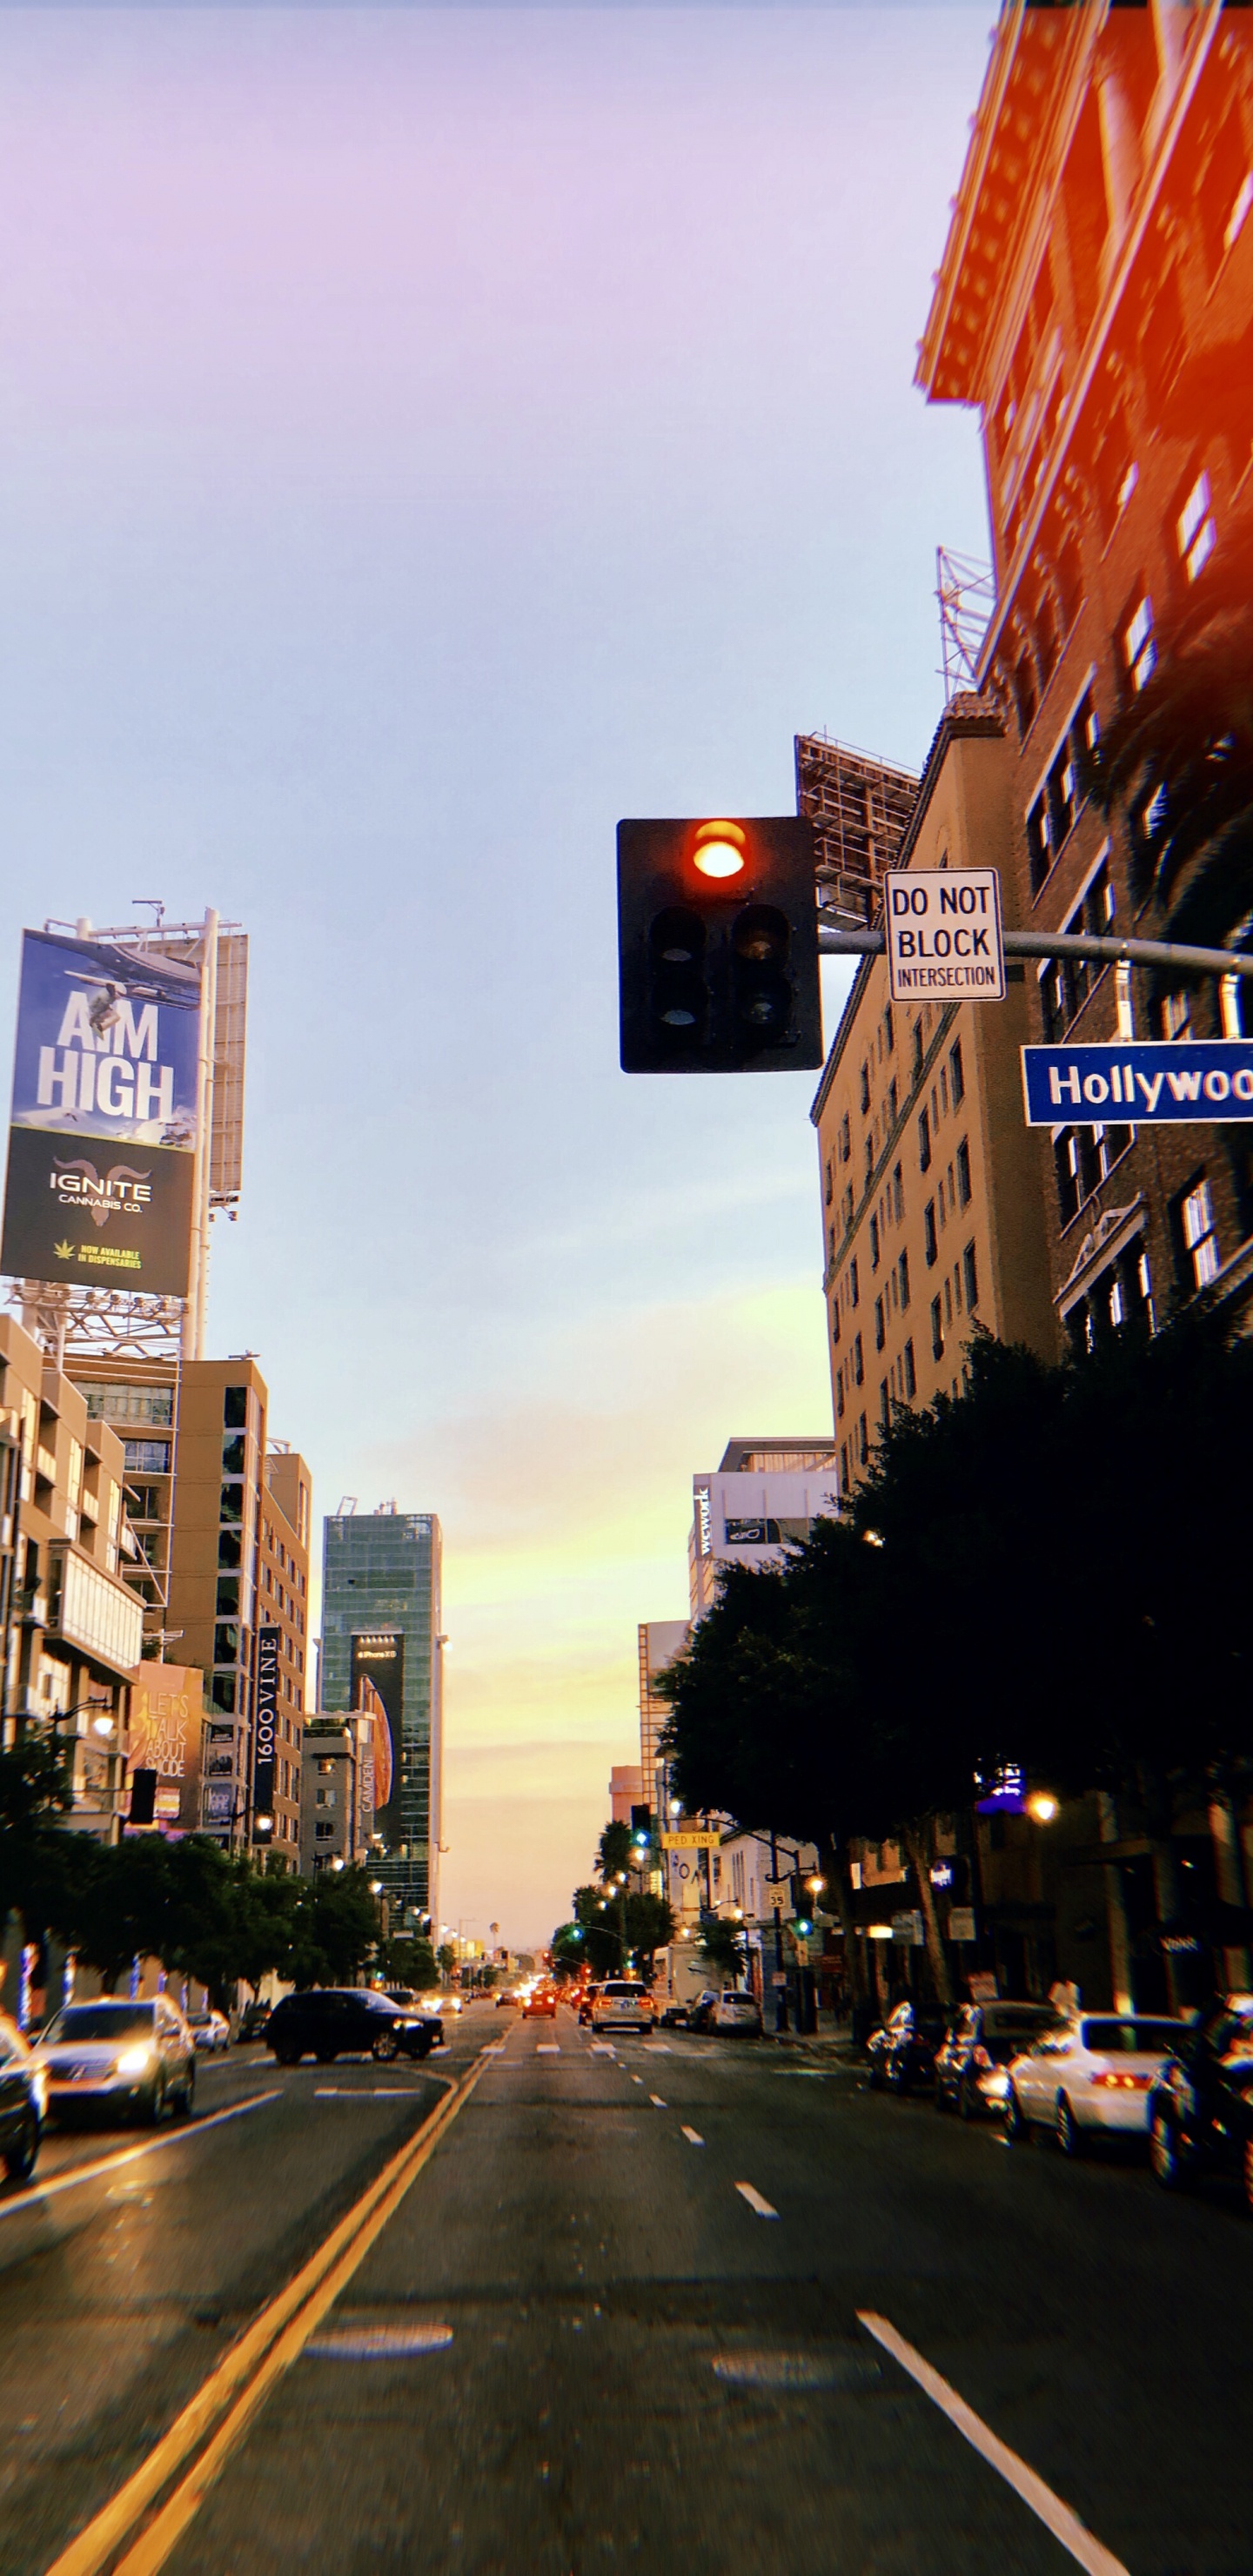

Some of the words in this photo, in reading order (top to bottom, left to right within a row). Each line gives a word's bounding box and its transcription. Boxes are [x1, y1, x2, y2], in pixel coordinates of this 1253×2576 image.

[893, 888, 928, 916] DO
[940, 886, 990, 915] NOT
[899, 929, 990, 957] BLOCK
[898, 965, 995, 988] INTERSECTION
[37, 1046, 174, 1120] HIGH
[1049, 1064, 1253, 1112] Hollywoo
[50, 1172, 151, 1202] IGNITE
[58, 1194, 122, 1211] CANNABIS
[124, 1203, 143, 1213] CO.
[77, 1253, 86, 1262] IN
[88, 1254, 142, 1269] DISPENSARIES
[81, 1244, 99, 1254] NOW
[100, 1247, 140, 1259] AVAILABLE
[694, 1487, 711, 1556] wework
[259, 1638, 277, 1704] VINE
[148, 1692, 189, 1718] LET'S
[148, 1715, 188, 1741] TALK
[257, 1708, 274, 1765] 1600
[145, 1738, 187, 1760] ABOUT
[145, 1756, 185, 1777] SICIDE
[361, 1760, 373, 1813] CAMDEN
[668, 1835, 687, 1845] PED
[692, 1835, 714, 1844] XING
[771, 1896, 784, 1905] 35
